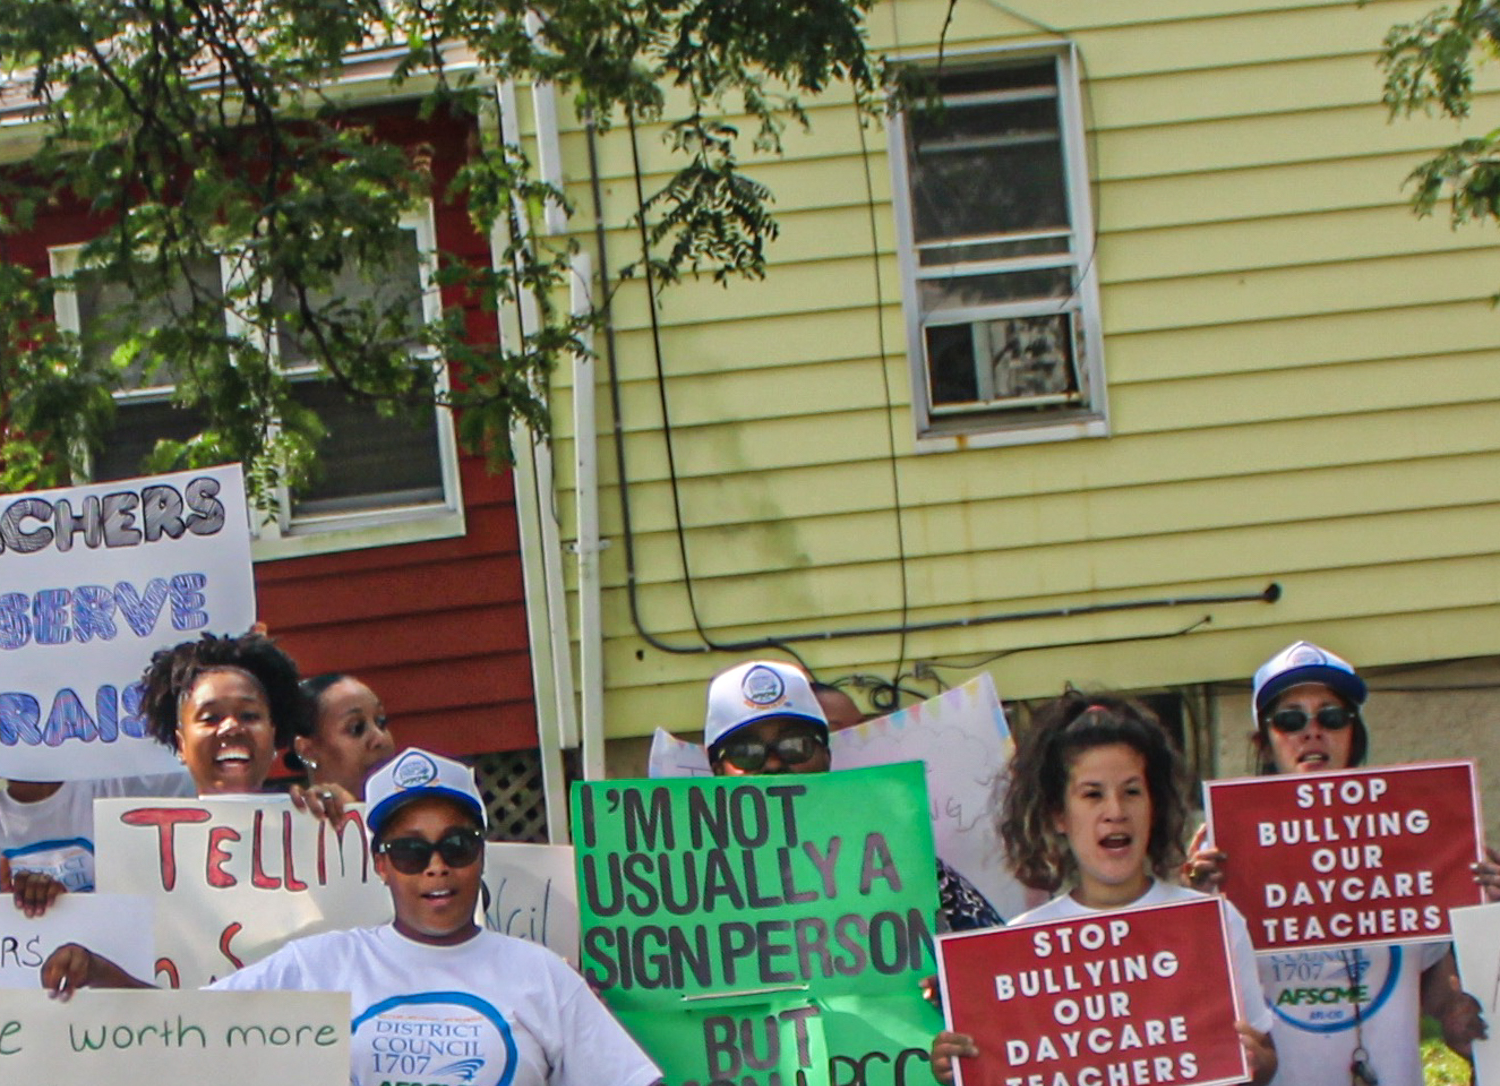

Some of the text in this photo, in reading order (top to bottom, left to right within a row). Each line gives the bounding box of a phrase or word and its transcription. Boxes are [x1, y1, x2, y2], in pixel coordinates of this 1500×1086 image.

[1297, 778, 1388, 810] STOP
[581, 784, 807, 852] I'M NOT
[1258, 809, 1430, 847] BULLYING
[583, 832, 902, 917] USUALLY A
[1311, 845, 1383, 872] OUR
[1264, 871, 1434, 908] DAYCARE
[1032, 920, 1131, 958] STOP
[1262, 906, 1442, 944] TEACHERS
[584, 909, 942, 992] SIGN PERSON
[995, 951, 1179, 1001] BULLYING
[1271, 962, 1323, 982] 1707
[1053, 992, 1129, 1025] OUR
[1277, 985, 1371, 1005] AFSCME
[69, 1015, 207, 1053] worth
[225, 1021, 338, 1048] more
[372, 1037, 484, 1057] COUNCIL
[375, 1021, 483, 1037] DISTRICT
[705, 1007, 819, 1081] BUT
[1005, 1017, 1189, 1067] DAYCARE
[373, 1053, 431, 1075] 1707
